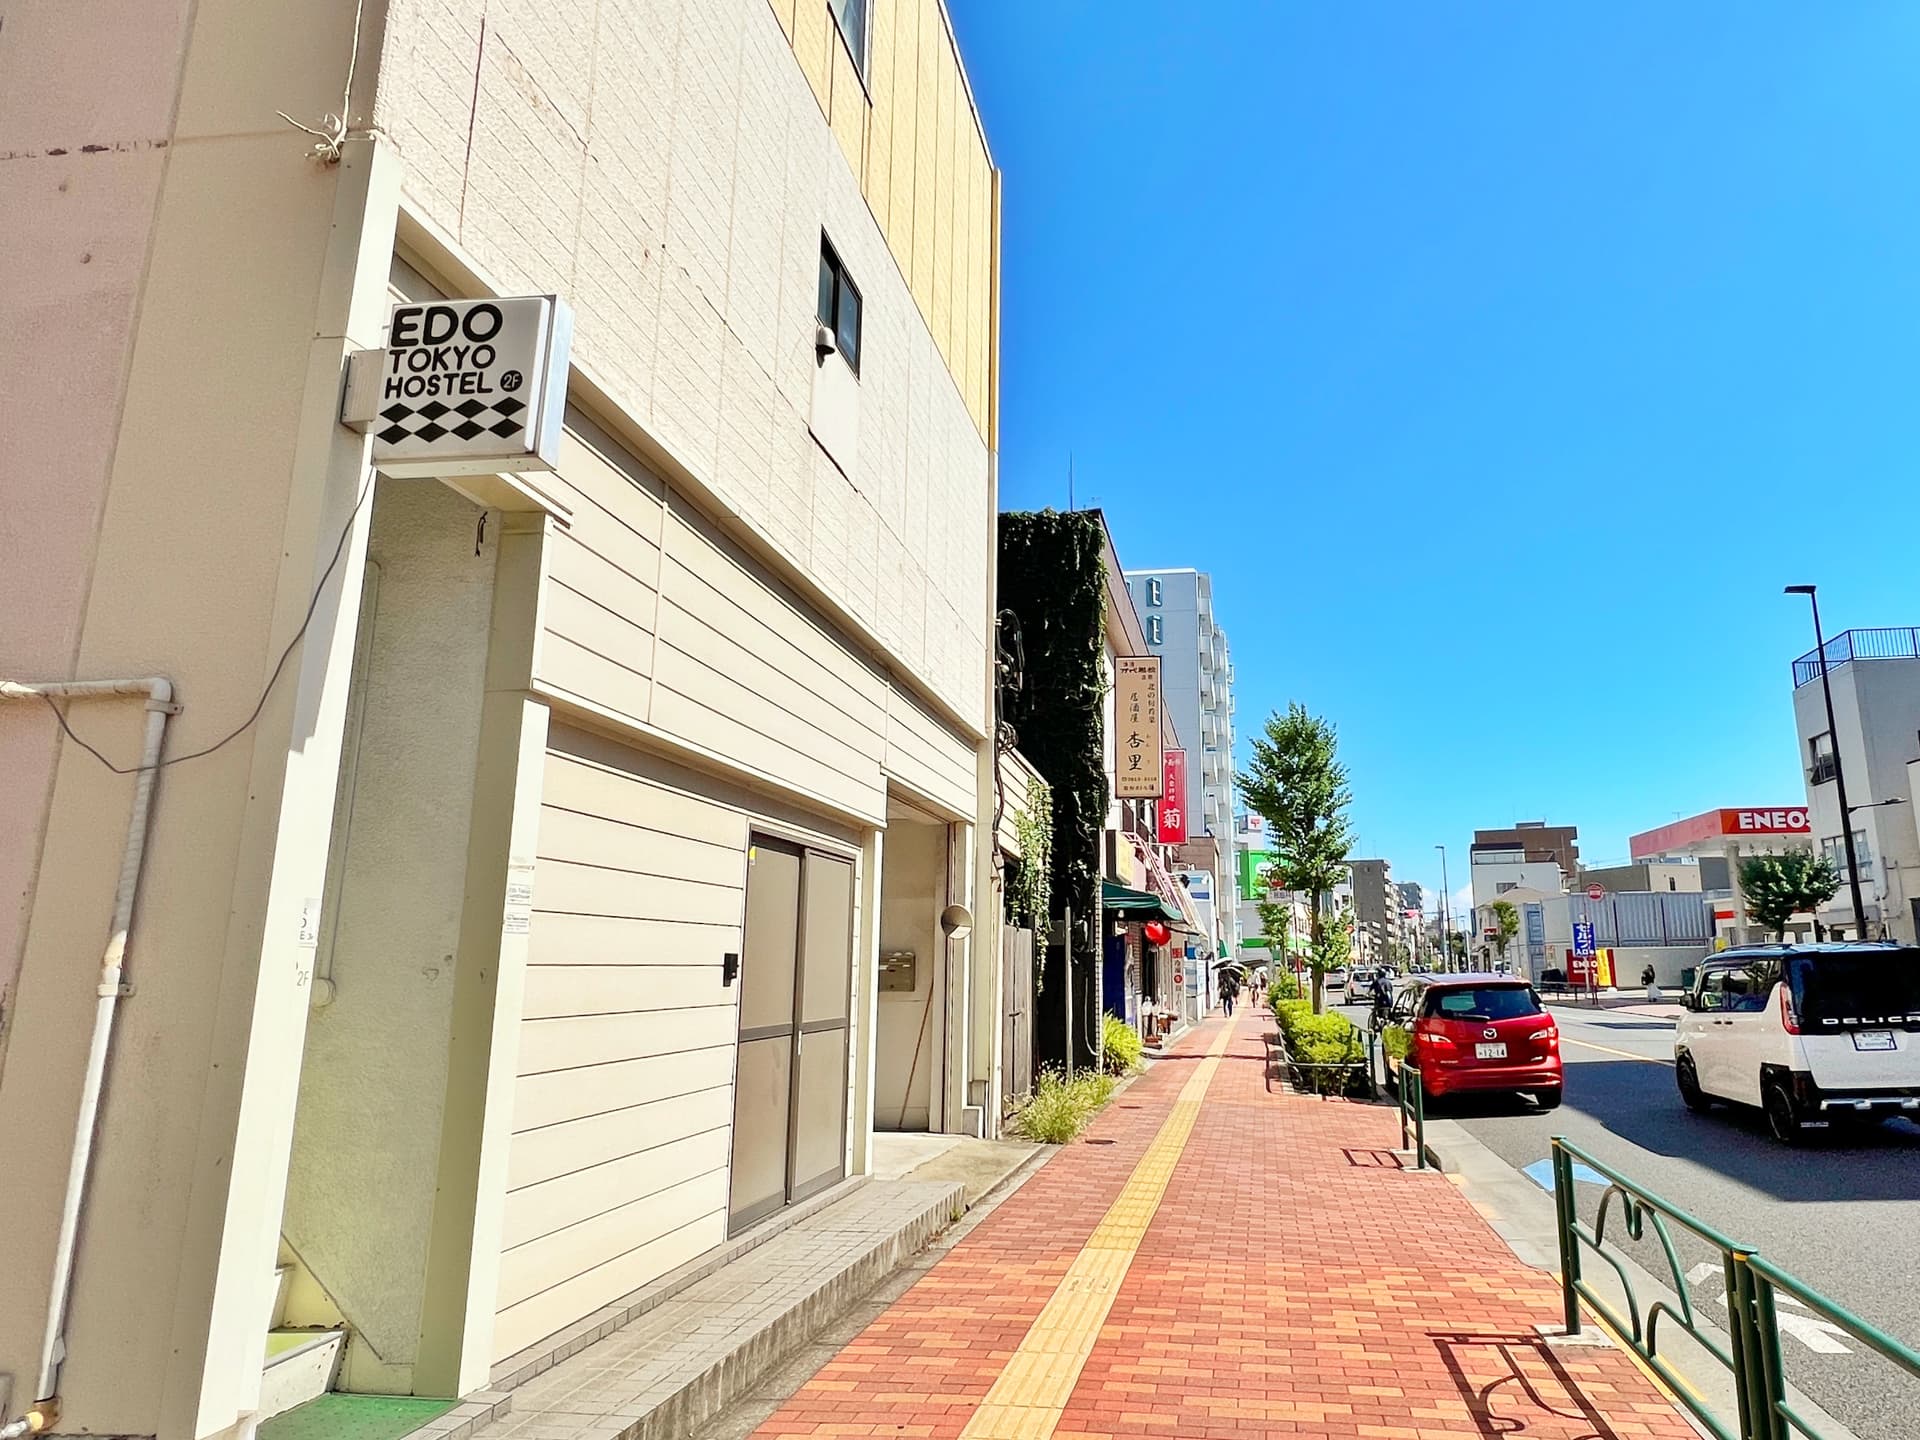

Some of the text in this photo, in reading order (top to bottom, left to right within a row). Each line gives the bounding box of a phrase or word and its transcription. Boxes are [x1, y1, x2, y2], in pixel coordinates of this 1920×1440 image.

[390, 303, 503, 347] EDO
[388, 344, 496, 374] TOKYO
[384, 371, 520, 399] HOSTEL 2F
[1126, 731, 1145, 771] 杏里
[1163, 808, 1181, 829] 菊
